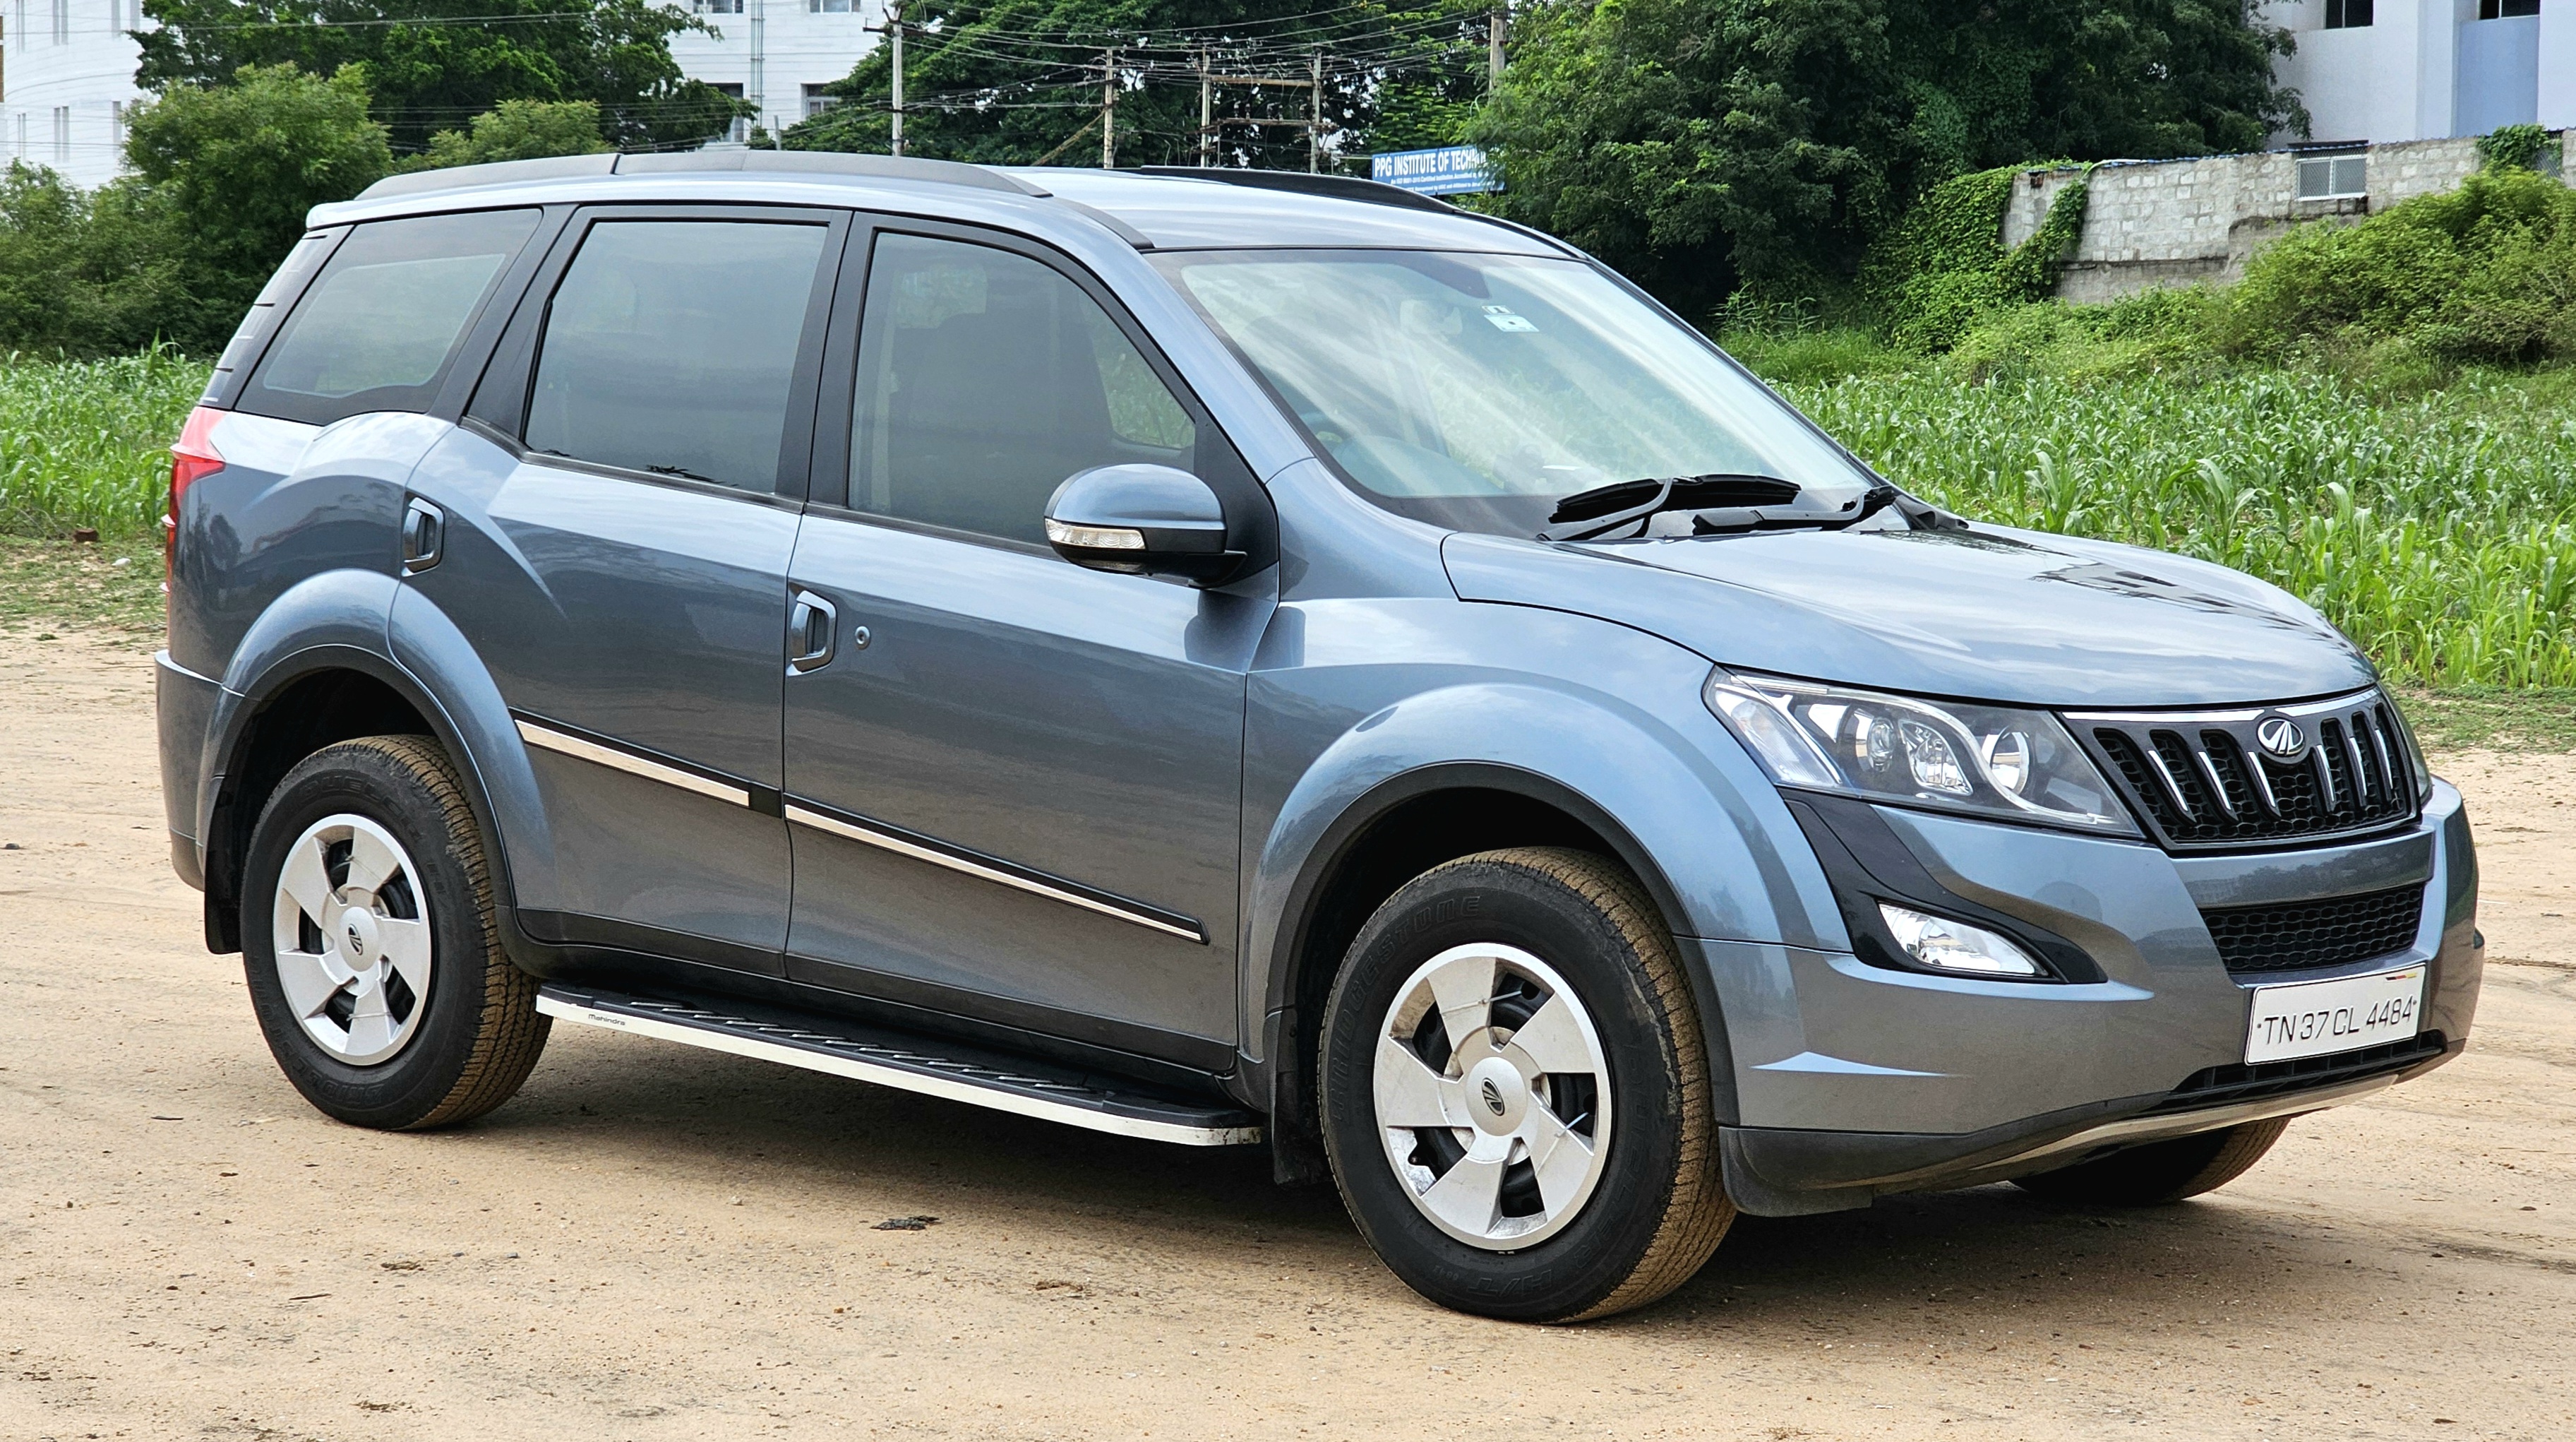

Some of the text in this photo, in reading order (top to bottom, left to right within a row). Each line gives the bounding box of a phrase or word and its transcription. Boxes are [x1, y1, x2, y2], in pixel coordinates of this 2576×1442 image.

[1374, 155, 1392, 177] PPG
[1394, 153, 1436, 176] INSTITUTE
[1437, 150, 1449, 172] OF
[2263, 994, 2414, 1045] TN 37 CL 4484
